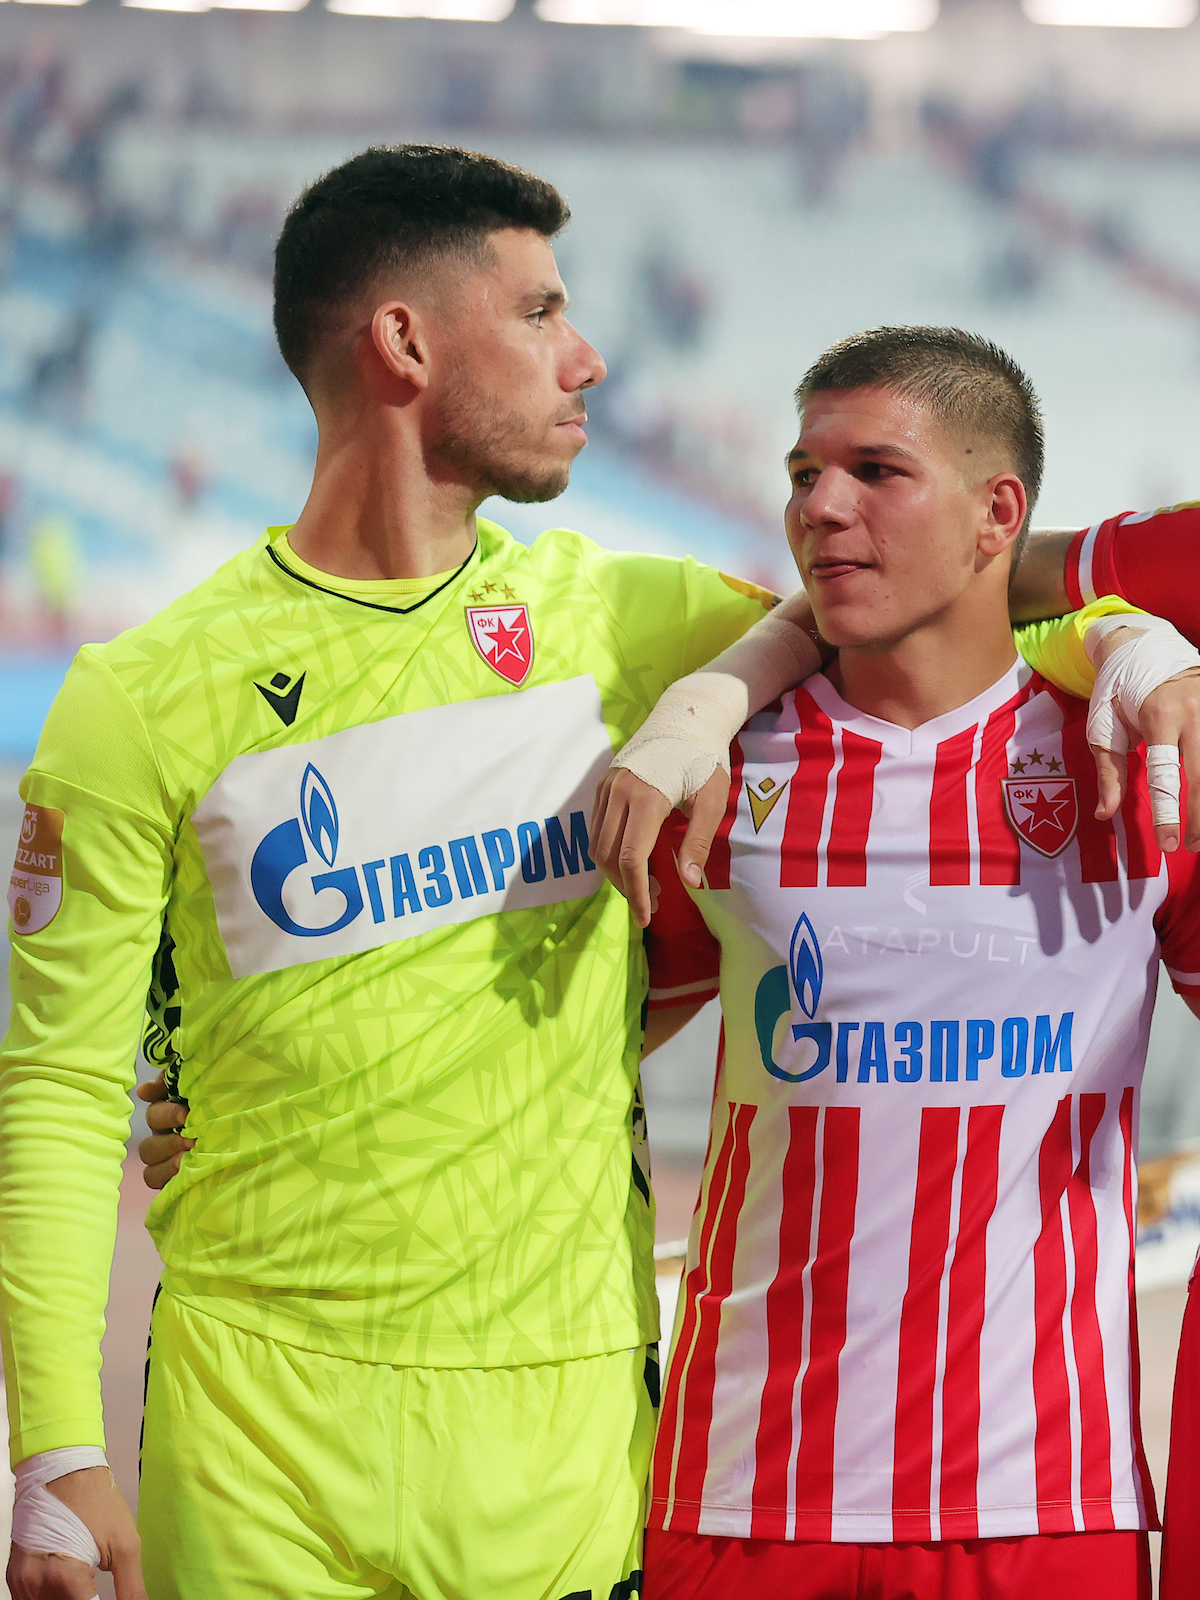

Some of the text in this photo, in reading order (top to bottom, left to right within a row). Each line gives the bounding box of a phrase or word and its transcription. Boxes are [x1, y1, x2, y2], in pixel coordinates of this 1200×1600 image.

[477, 617, 495, 628] ФК
[1013, 789, 1034, 799] ФК
[14, 847, 57, 870] ZZART
[362, 811, 597, 924] ГАЗПРОМ
[792, 923, 1038, 965] ATAPULT
[836, 1011, 1074, 1083] ГАЗПРОМ
